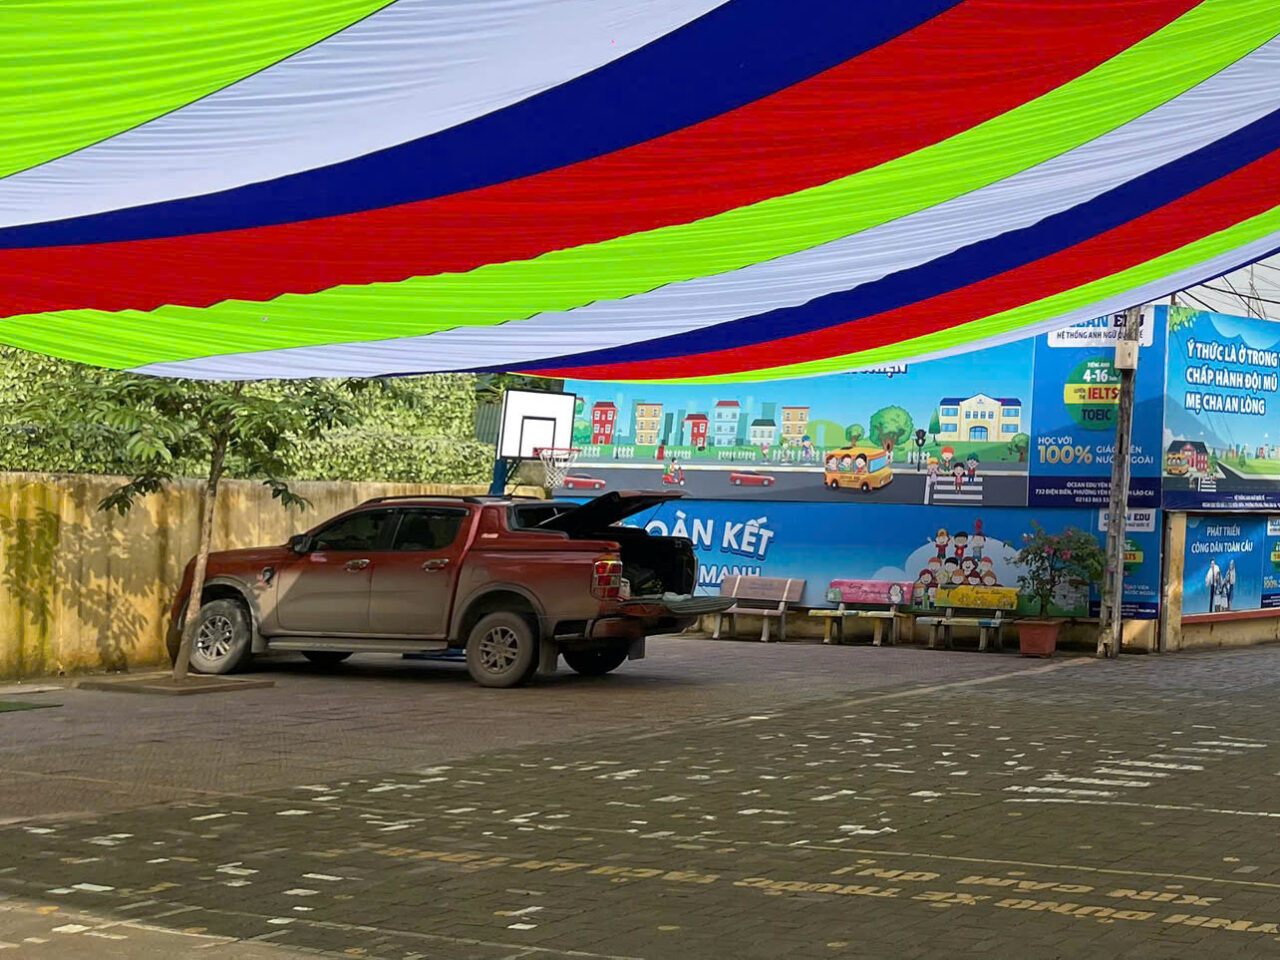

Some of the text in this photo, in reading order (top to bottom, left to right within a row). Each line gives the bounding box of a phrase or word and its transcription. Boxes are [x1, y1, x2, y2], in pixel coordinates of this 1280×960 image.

[1056, 330, 1065, 340] HỆ
[1066, 329, 1087, 340] THỐNG
[1187, 339, 1195, 357] Ý
[1196, 341, 1223, 361] THỨC
[1225, 345, 1236, 362] LÀ
[1238, 344, 1246, 363] Ở
[1247, 349, 1277, 367] TRONG
[1083, 369, 1108, 382] 4-16
[1186, 364, 1278, 393] CHẤP HÀNH ĐỘI MŨ
[1087, 387, 1118, 400] IELTS
[1186, 392, 1265, 414] MẸ CHA AN LÒNG
[1082, 409, 1112, 420] TOEIC
[1038, 435, 1072, 445] HỌC VỚI
[1038, 445, 1092, 464] 100%
[1134, 513, 1150, 521] EDU
[722, 516, 774, 557] KẾT
[1206, 523, 1240, 537] PHÁT TRIỂN
[1191, 539, 1253, 553] CÔNG DÂN TOÀN CẦU
